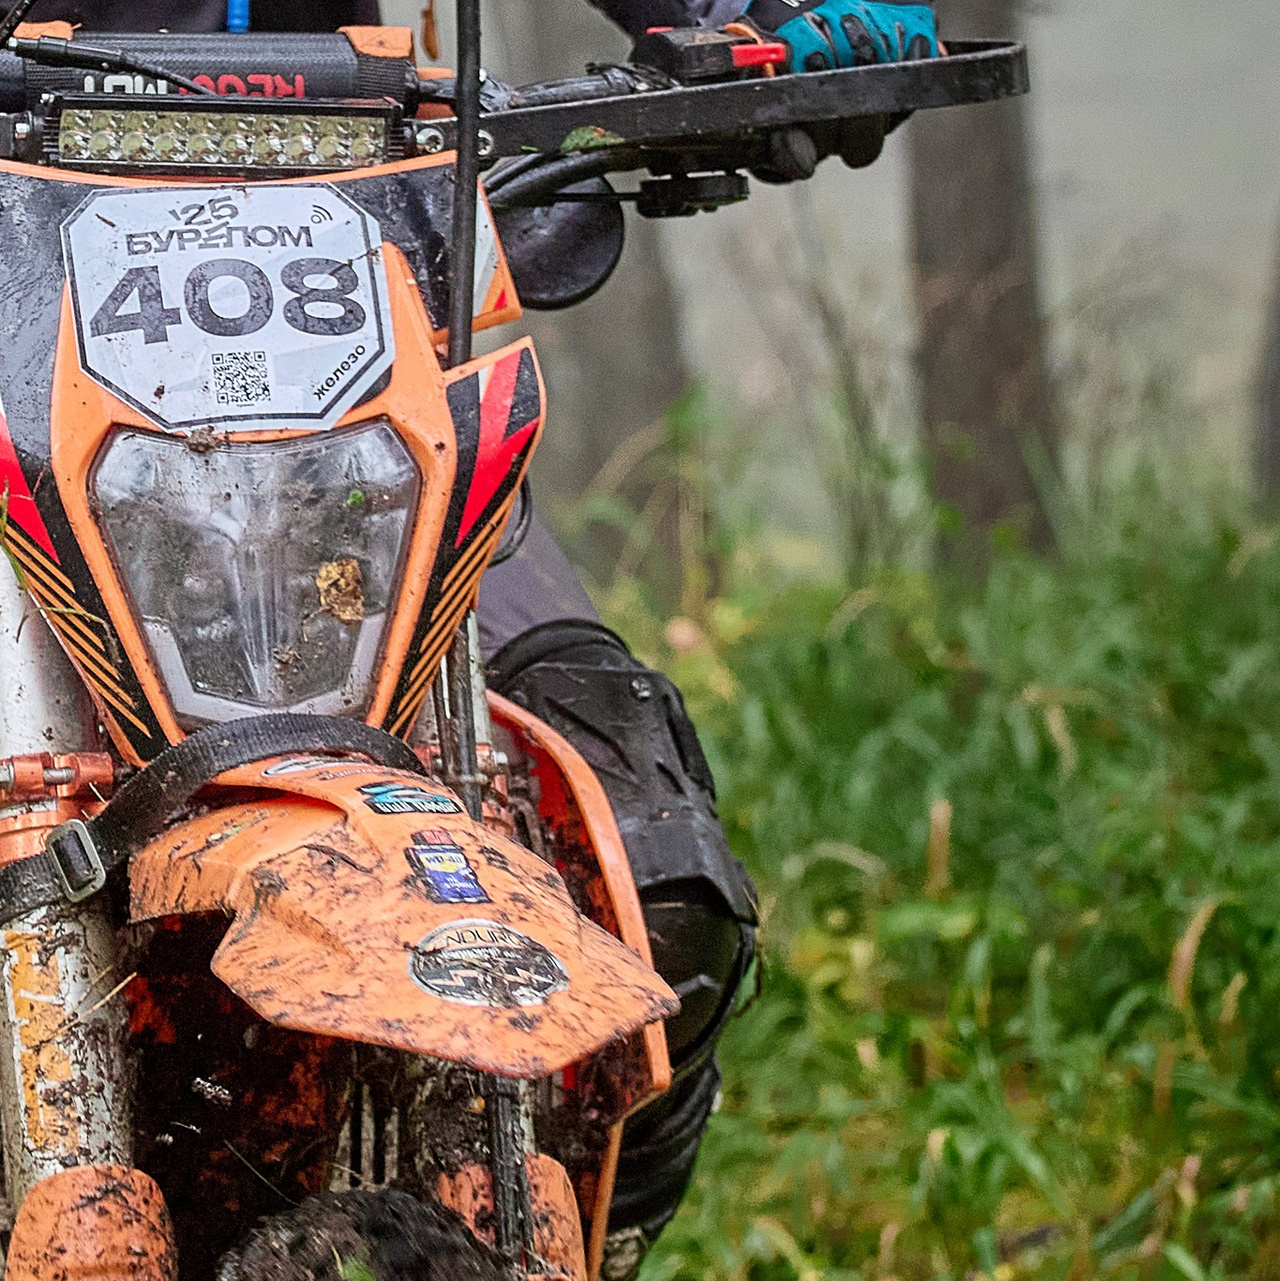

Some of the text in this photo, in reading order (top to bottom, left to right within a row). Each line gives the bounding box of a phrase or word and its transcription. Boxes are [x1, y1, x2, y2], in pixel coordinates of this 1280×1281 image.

[90, 258, 366, 345] 408
[313, 344, 366, 401] железо
[432, 928, 522, 948] NDURO
